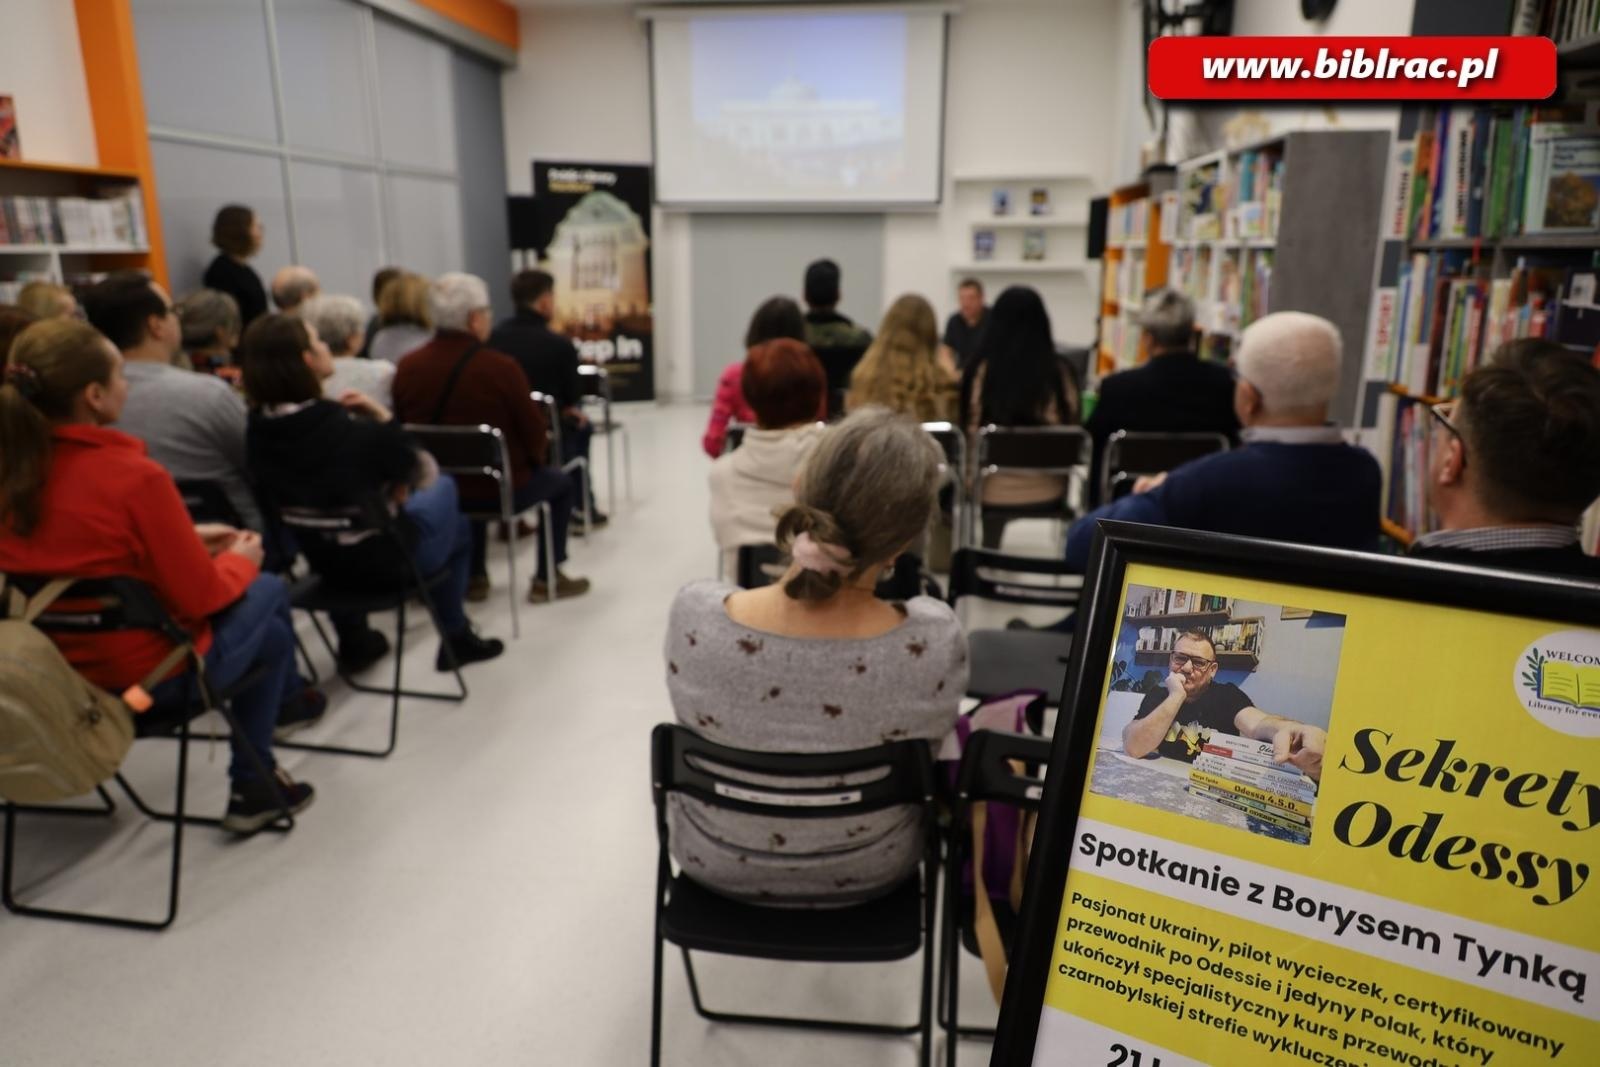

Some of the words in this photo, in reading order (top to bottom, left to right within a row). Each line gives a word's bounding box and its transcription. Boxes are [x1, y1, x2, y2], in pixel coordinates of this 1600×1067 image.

[1528, 700, 1563, 714] Library
[1565, 706, 1579, 715] for
[1581, 710, 1600, 719] eve
[1234, 784, 1266, 801] Odessa
[1267, 796, 1299, 812] 4.5.0.
[1338, 728, 1600, 832] Sekrety
[1333, 801, 1590, 906] Odessy
[1079, 832, 1240, 897] Spotkanie
[1246, 882, 1265, 905] z
[1272, 884, 1441, 955] Borysem
[1453, 933, 1587, 1004] Tynką
[1058, 963, 1185, 1020] czarnobylskiej
[1187, 1008, 1248, 1038] strefie
[1252, 1030, 1368, 1067] wyklucze
[1063, 940, 1140, 976] ukończył
[1143, 966, 1290, 1028] specjalistyczny
[1293, 1013, 1339, 1041] kurs
[1342, 1032, 1460, 1067] przewod
[1066, 917, 1166, 958] przewodnik
[1168, 949, 1193, 966] po
[1196, 956, 1272, 992] Odessie
[1276, 979, 1283, 995] i
[1283, 982, 1357, 1023] jedyny
[1360, 1007, 1426, 1044] Polak,
[1432, 1029, 1495, 1067] który
[1071, 892, 1146, 926] Pasjonat
[1149, 915, 1225, 954] Ukrainy,
[1228, 942, 1272, 966] pilot
[1276, 956, 1388, 1004] wycieczek,
[1393, 993, 1565, 1059] certyfikowany
